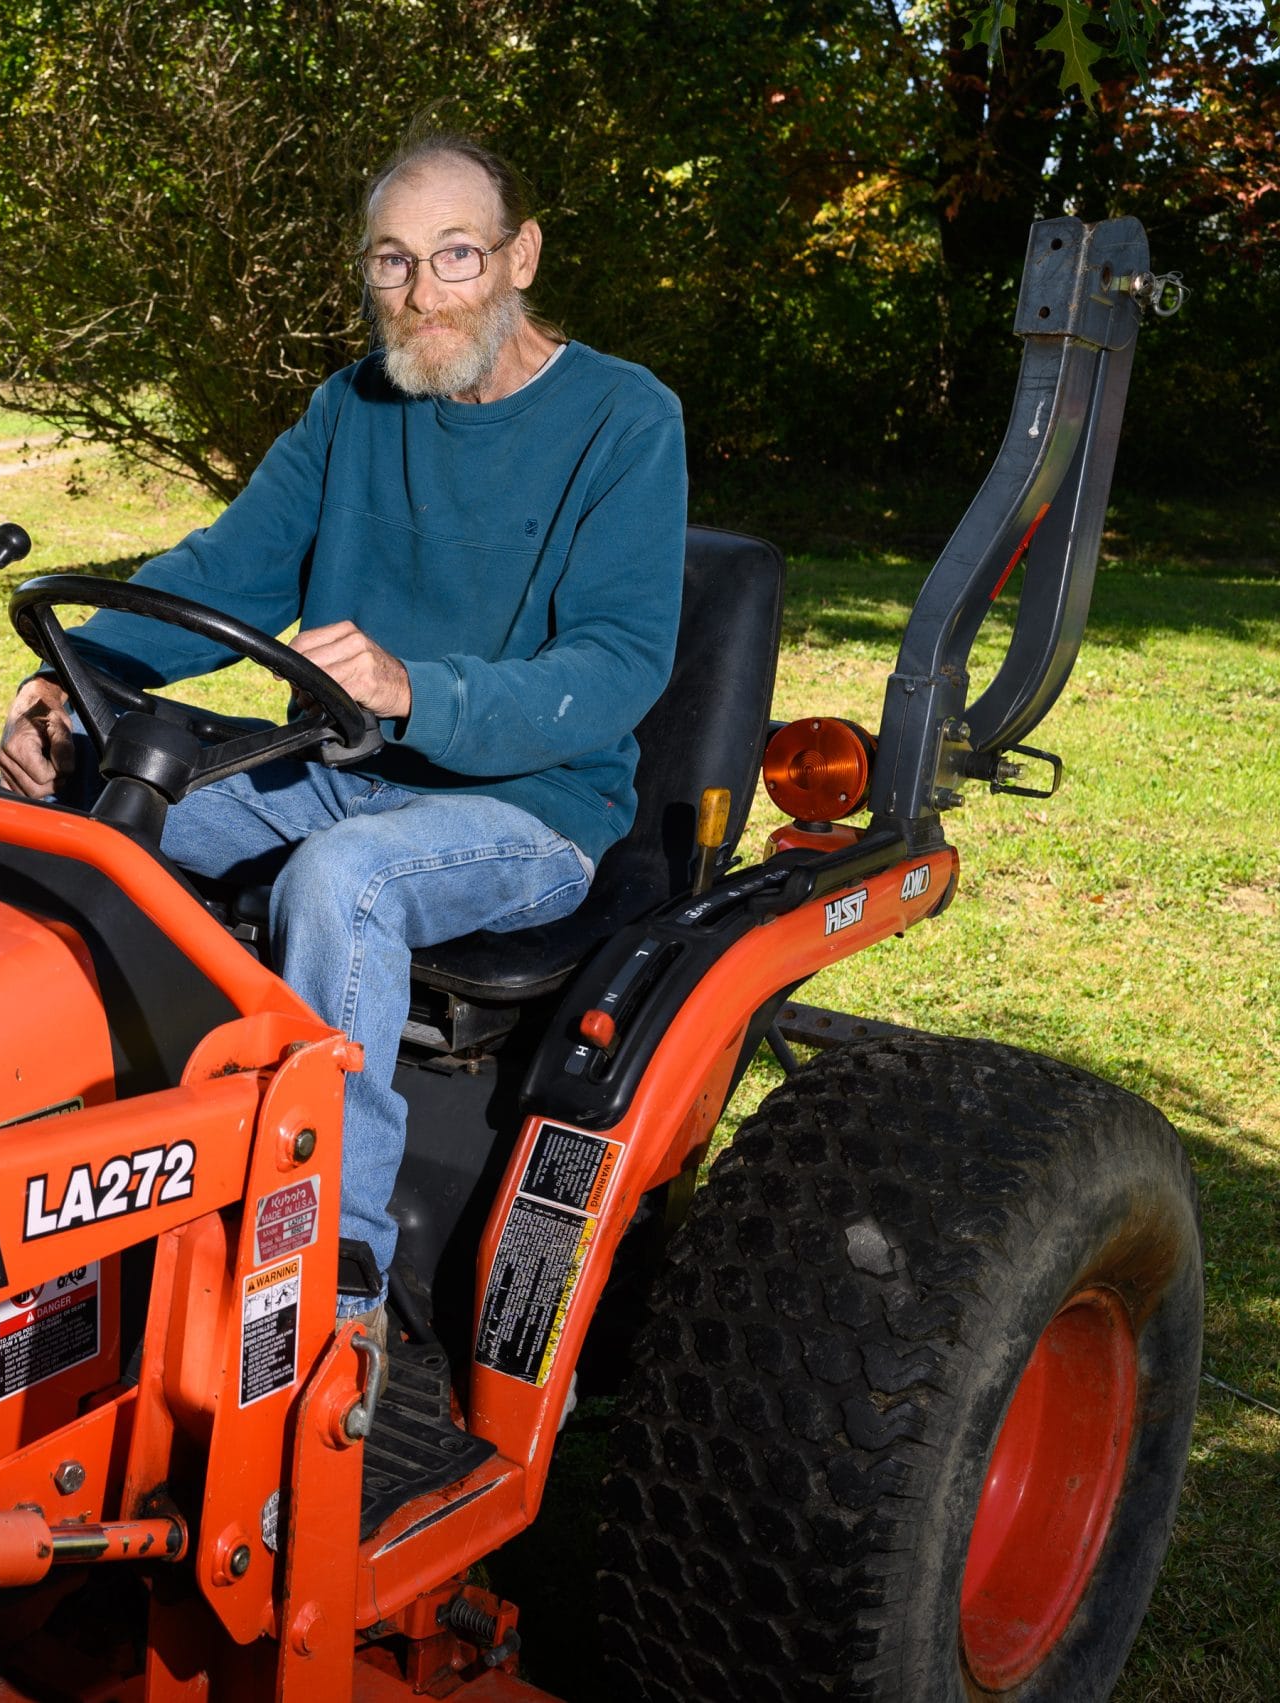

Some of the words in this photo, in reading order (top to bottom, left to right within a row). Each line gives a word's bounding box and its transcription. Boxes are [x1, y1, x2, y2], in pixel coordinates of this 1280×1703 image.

[900, 864, 930, 902] 4WD
[824, 888, 868, 936] HST
[575, 1045, 589, 1057] H
[23, 1141, 198, 1242] LA272
[590, 1164, 611, 1207] WARNING
[261, 1212, 282, 1224] MADE
[285, 1205, 293, 1214] IN
[256, 1262, 298, 1288] WARNING
[36, 1296, 72, 1317] DANGER
